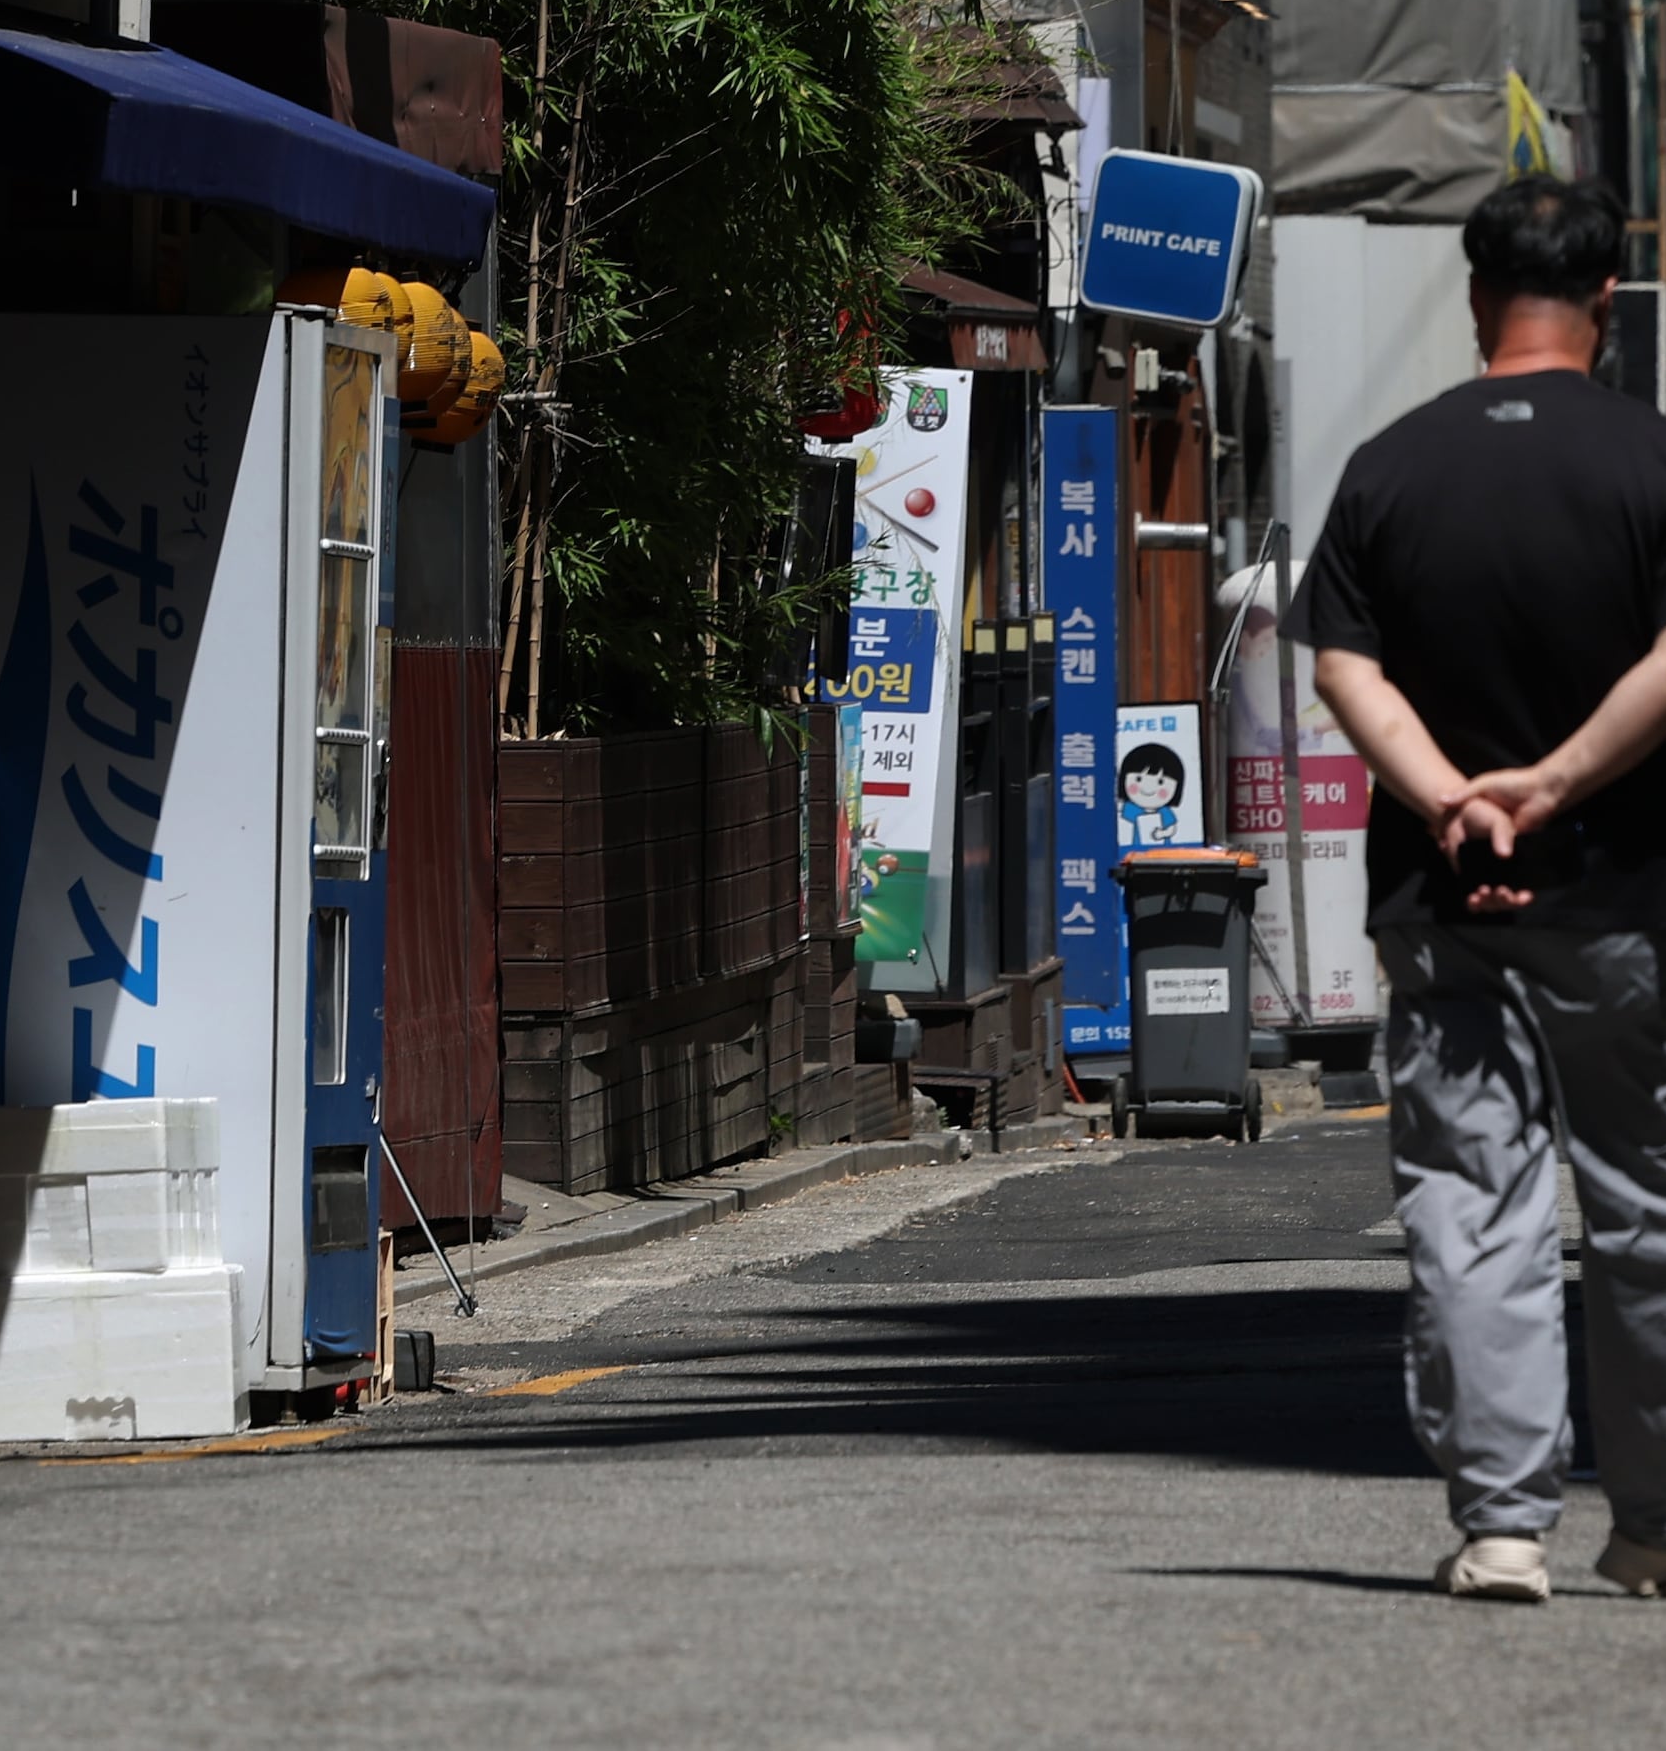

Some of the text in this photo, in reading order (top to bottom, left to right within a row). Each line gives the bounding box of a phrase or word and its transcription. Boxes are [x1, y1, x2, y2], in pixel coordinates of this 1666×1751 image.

[1101, 222, 1222, 258] PRINT CAFE
[184, 342, 211, 542] イオンサプライ
[1059, 478, 1099, 559] 복사
[849, 617, 891, 657] 분
[1059, 606, 1098, 686] 스캔
[873, 751, 914, 772] 제외
[1061, 732, 1097, 811] 출력
[1303, 782, 1347, 806] 케어
[1061, 857, 1097, 937] 팩스
[1332, 970, 1354, 991] 3F
